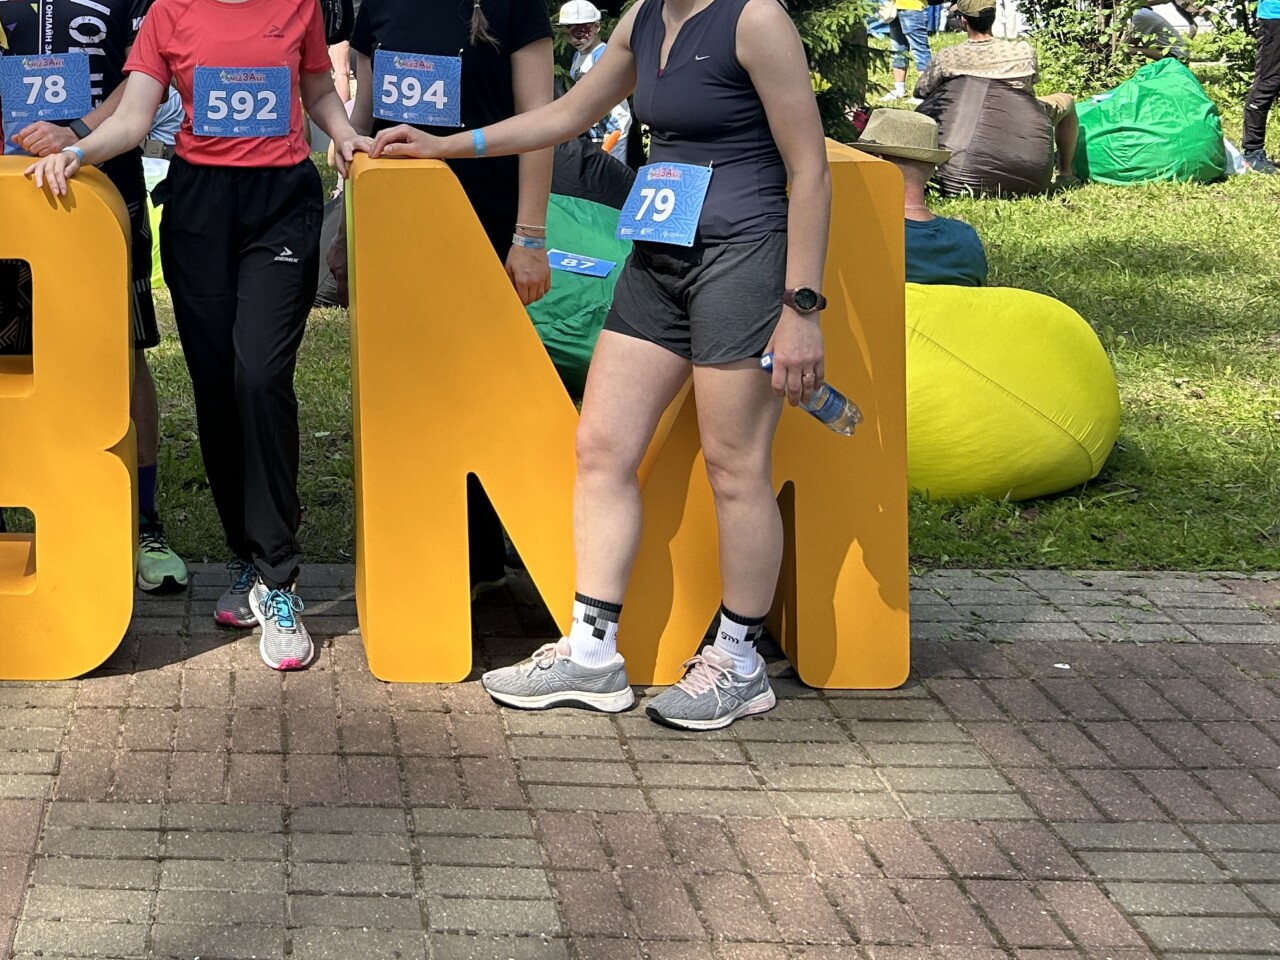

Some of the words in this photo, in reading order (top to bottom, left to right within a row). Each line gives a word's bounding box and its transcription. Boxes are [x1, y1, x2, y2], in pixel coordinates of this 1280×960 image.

[44, 4, 54, 42] ОНЛАЙН
[22, 74, 67, 105] 78
[207, 90, 277, 120] 592
[381, 74, 448, 110] 594
[635, 188, 676, 222] 79
[560, 258, 596, 269] 87
